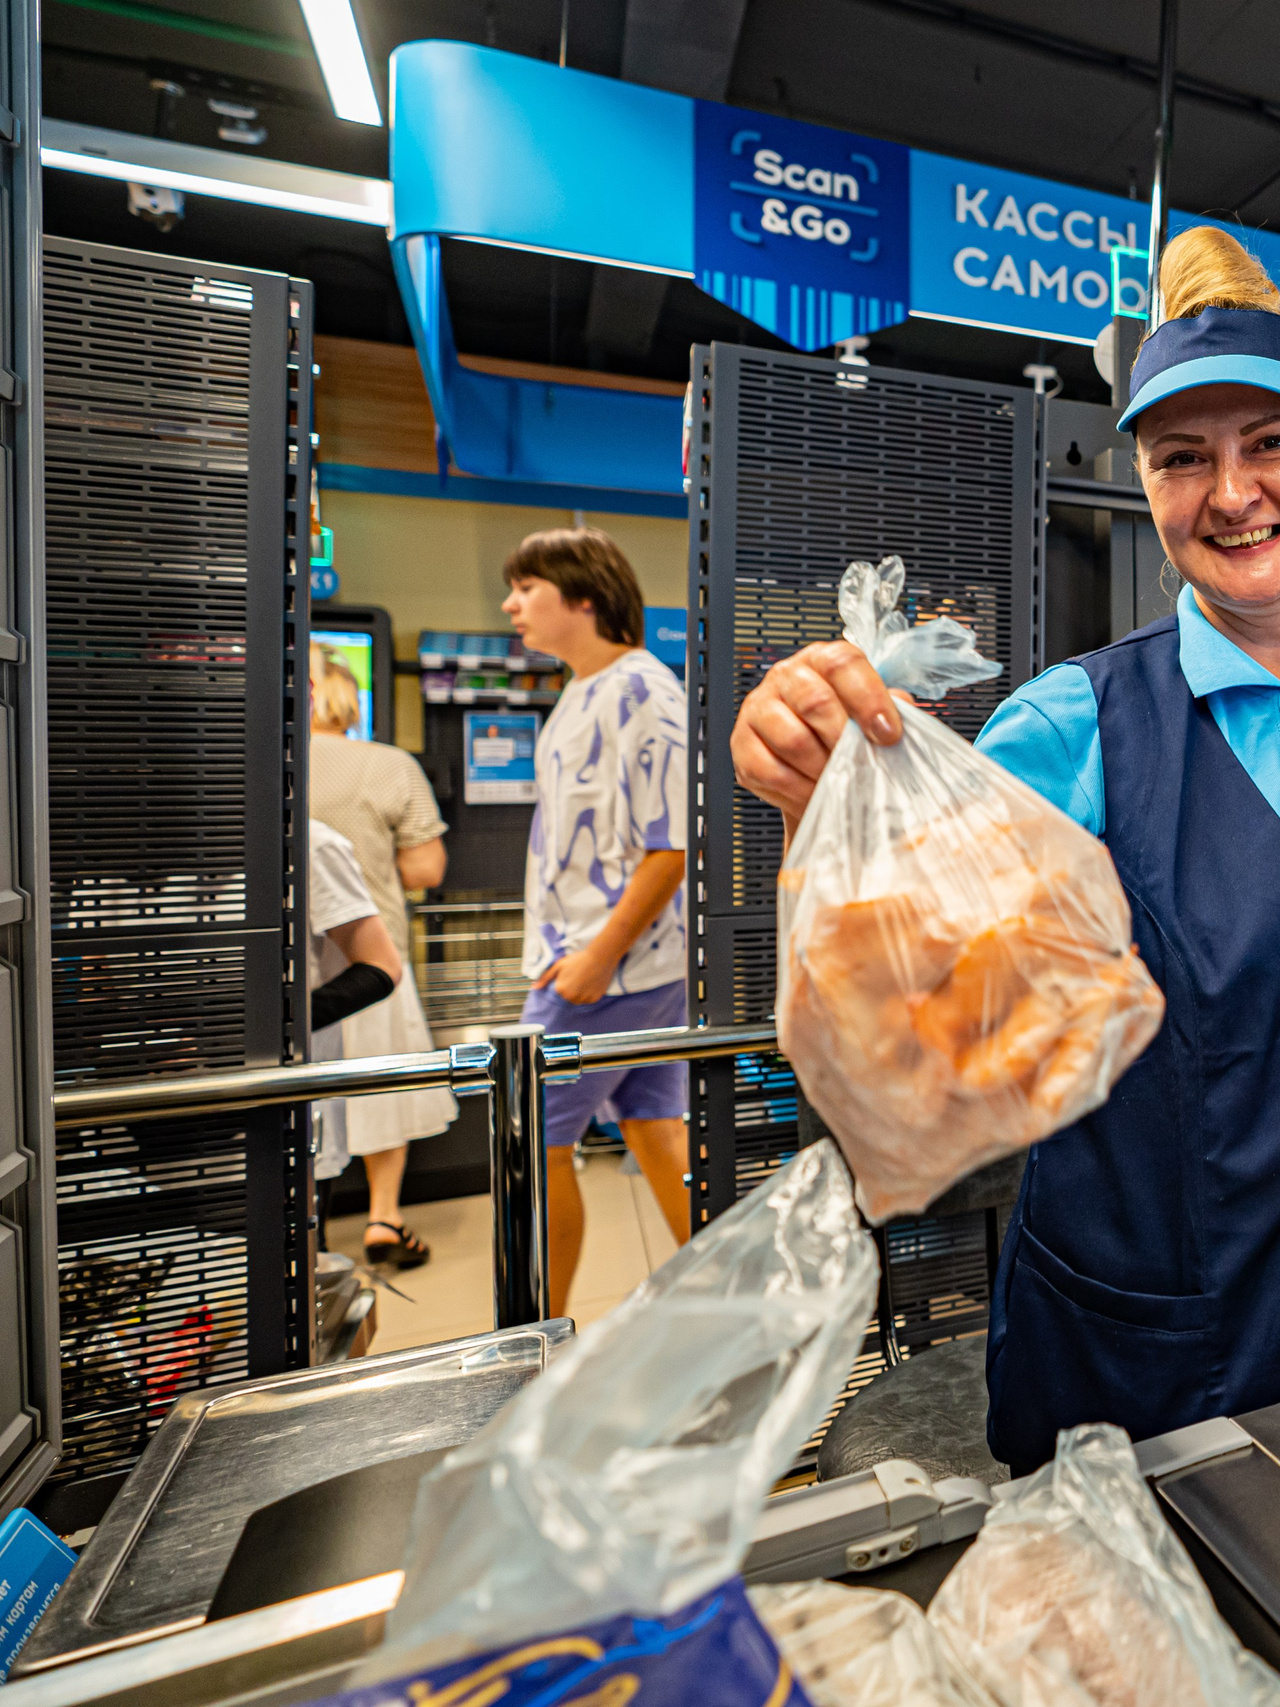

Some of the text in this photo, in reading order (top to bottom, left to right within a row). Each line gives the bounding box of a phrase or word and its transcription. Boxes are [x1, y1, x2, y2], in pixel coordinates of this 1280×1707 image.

[753, 149, 860, 202] Scan
[760, 198, 852, 246] &Go
[955, 183, 1138, 257] КАССЫ
[5, 1580, 39, 1626] картам
